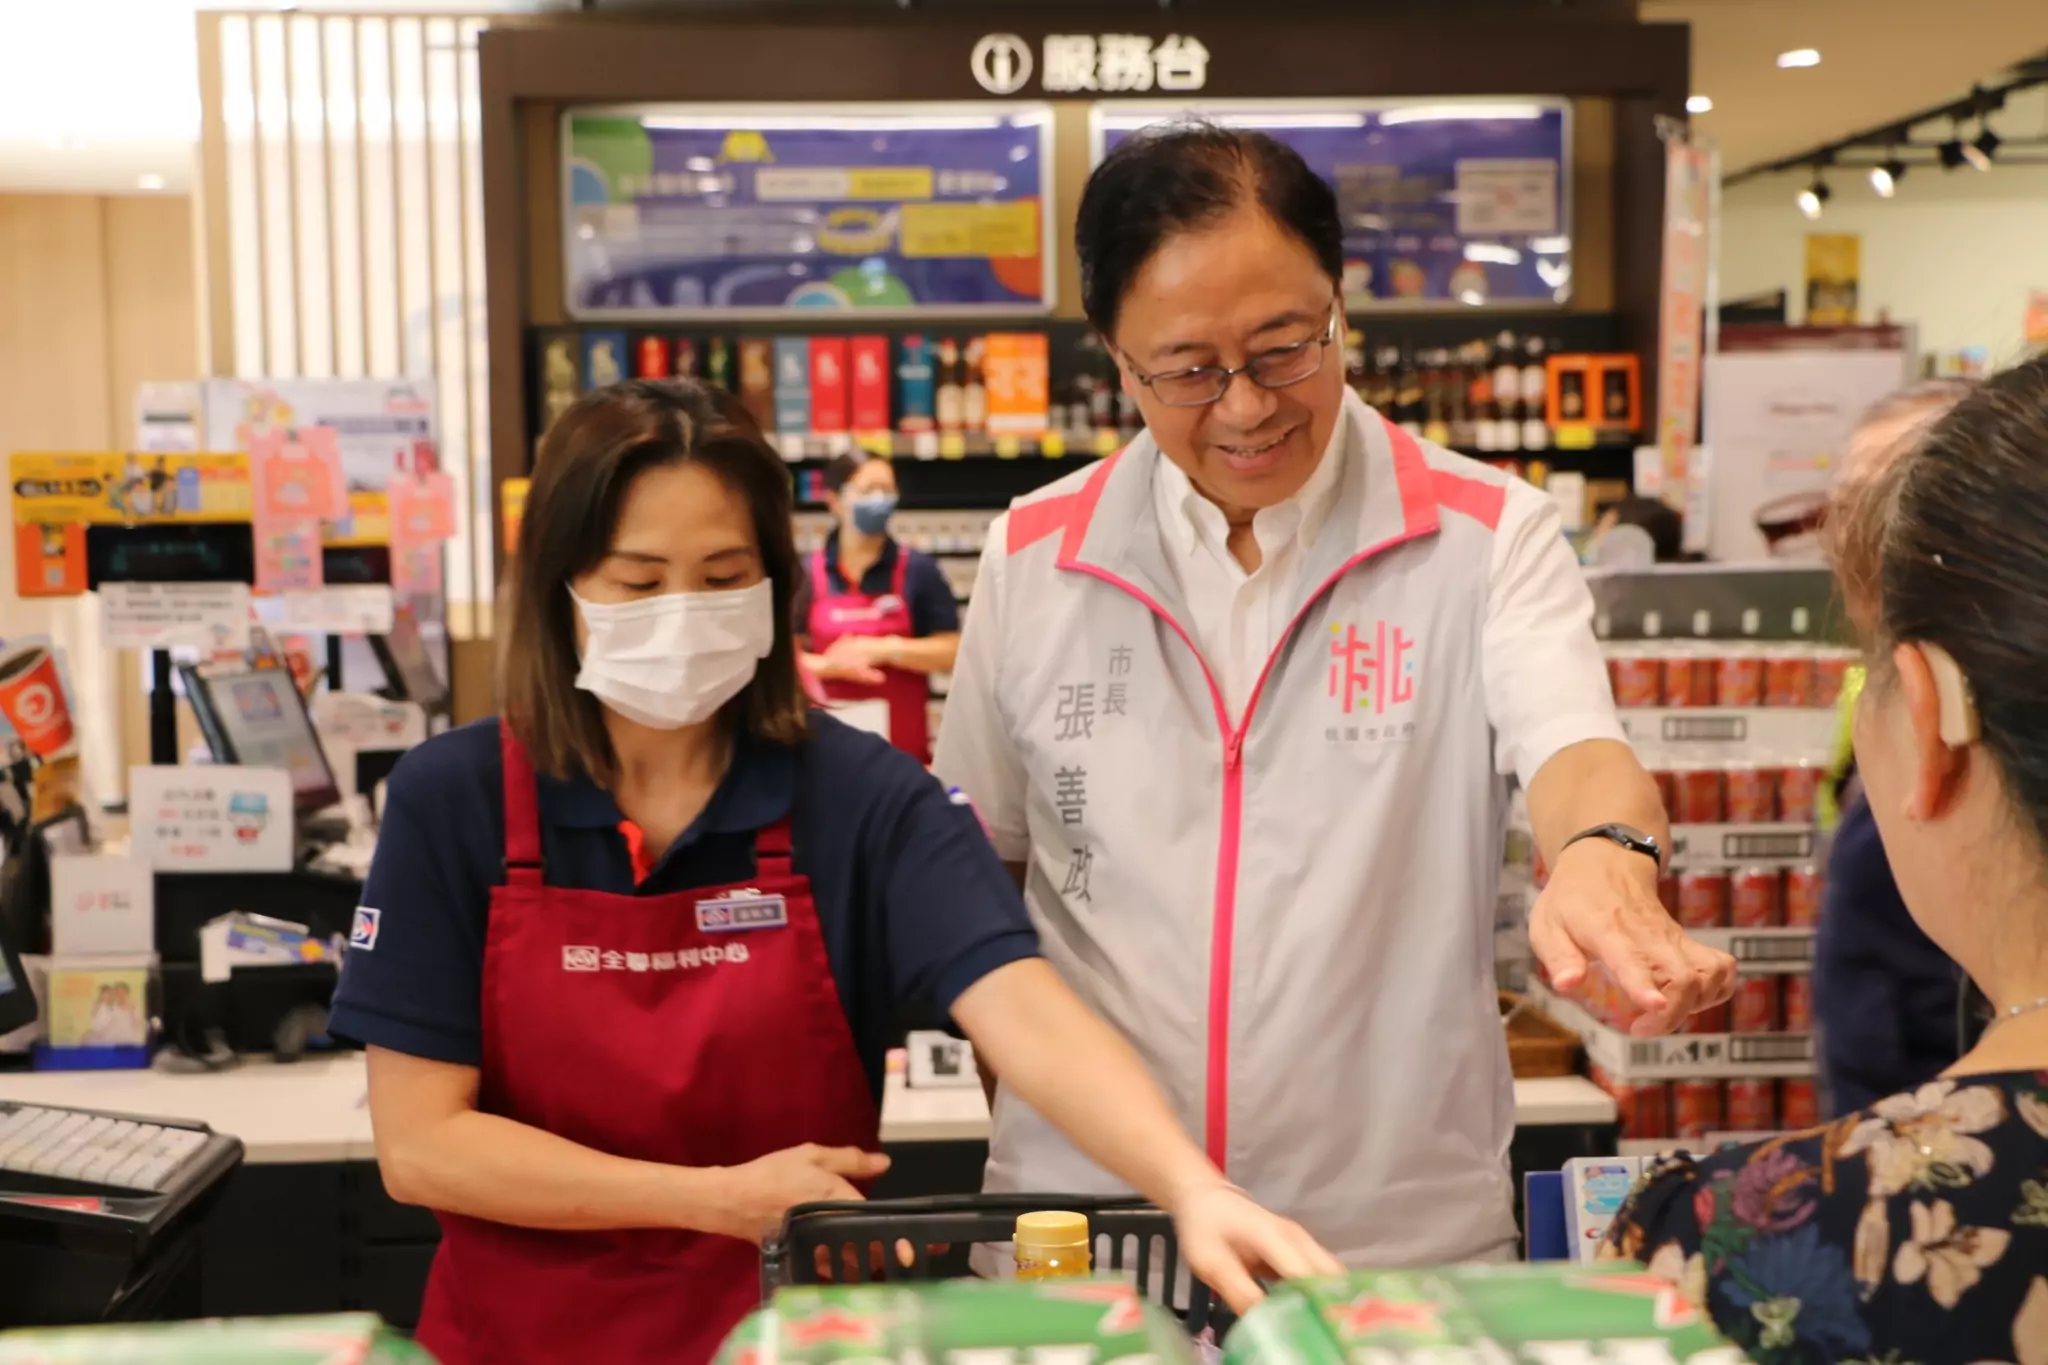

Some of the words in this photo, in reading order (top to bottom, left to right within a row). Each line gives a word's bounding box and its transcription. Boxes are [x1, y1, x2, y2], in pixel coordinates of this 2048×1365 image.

[1041, 34, 1210, 92] 服務台
[1101, 644, 1133, 716] 市長
[1053, 682, 1096, 903] 張善政
